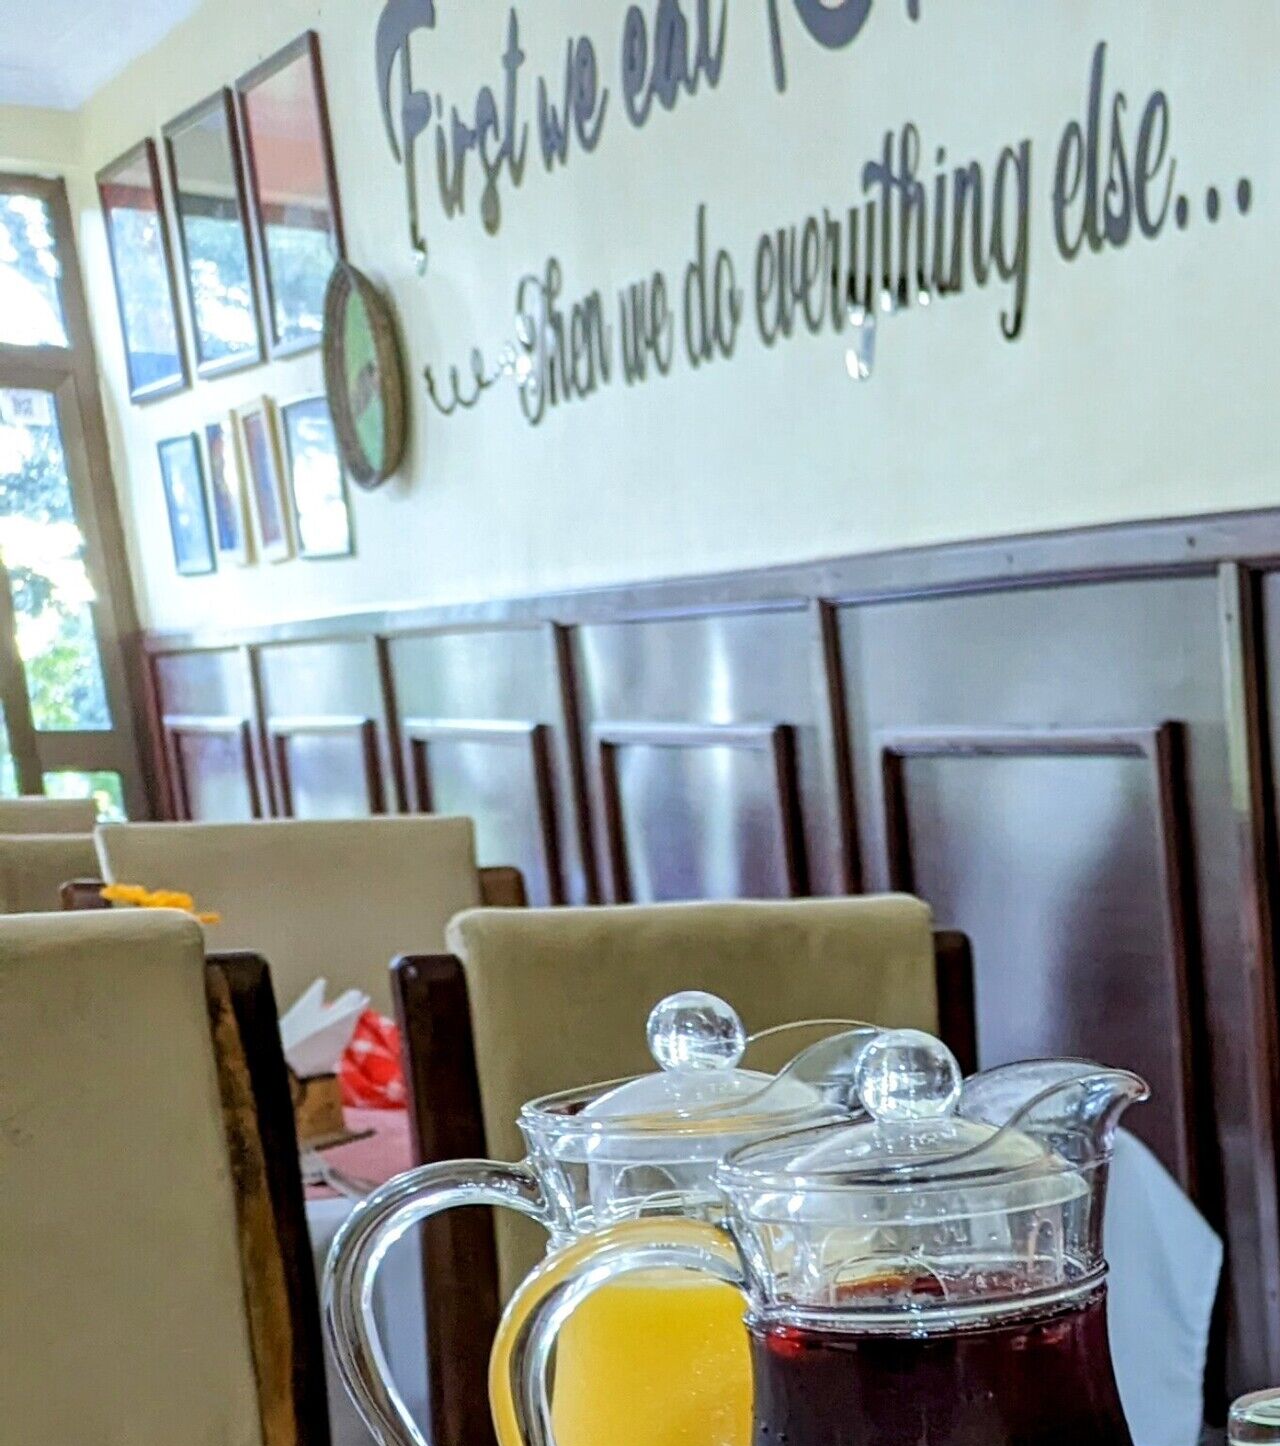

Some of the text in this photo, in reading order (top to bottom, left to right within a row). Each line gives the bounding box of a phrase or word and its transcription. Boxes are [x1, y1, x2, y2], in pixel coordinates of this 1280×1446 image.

[375, 0, 527, 256] First
[538, 36, 608, 173] we
[618, 271, 675, 386] we
[684, 203, 744, 369] do
[755, 122, 1031, 380] everything
